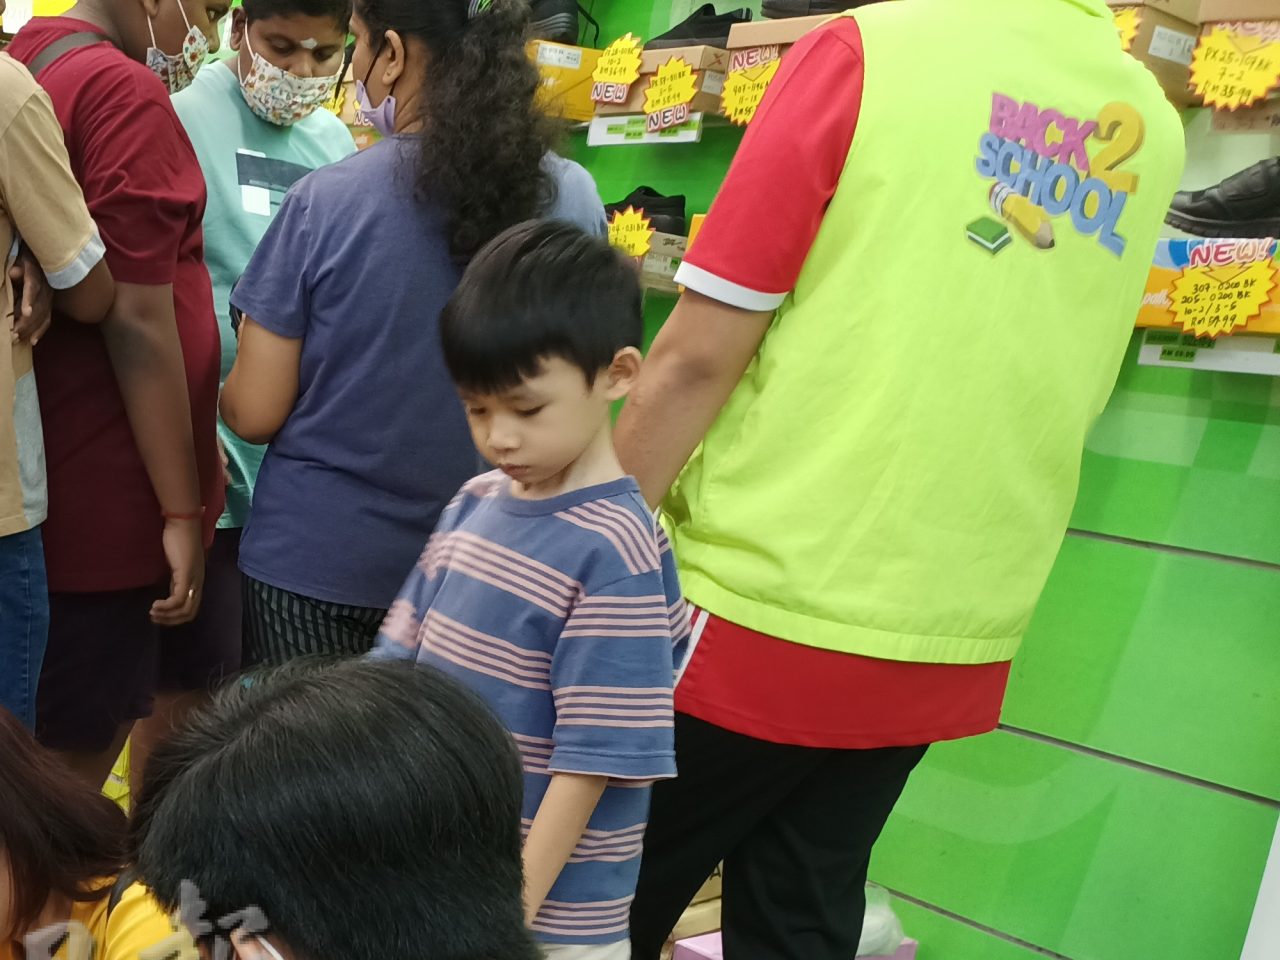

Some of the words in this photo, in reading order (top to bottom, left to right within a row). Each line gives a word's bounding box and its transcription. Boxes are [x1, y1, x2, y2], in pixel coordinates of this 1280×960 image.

[591, 84, 626, 100] NEW
[648, 105, 686, 129] NEW
[989, 91, 1098, 171] BACK
[1093, 101, 1144, 194] 2
[975, 132, 1129, 262] SCHOOL
[1190, 238, 1273, 266] NEW!
